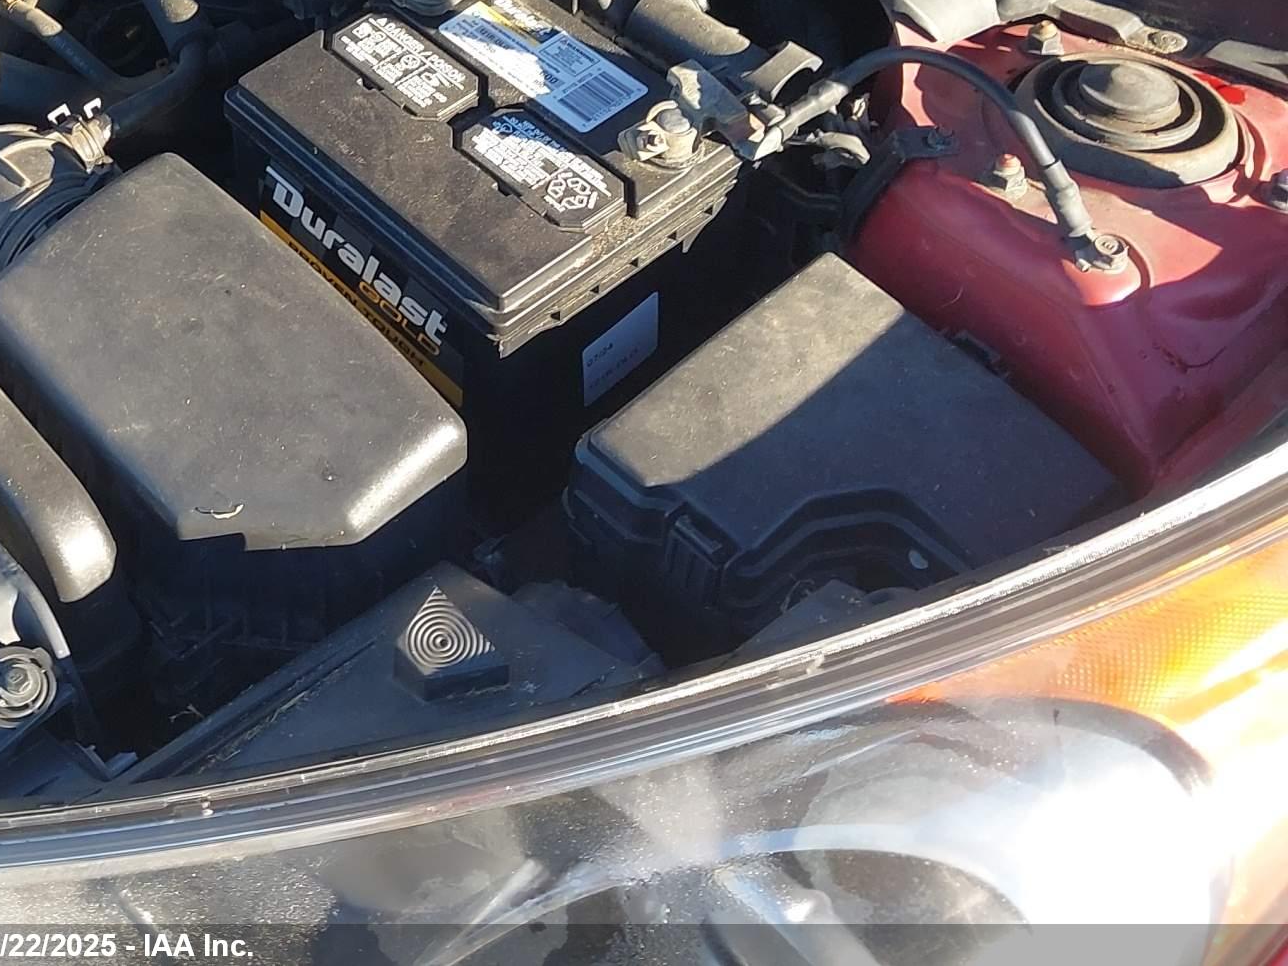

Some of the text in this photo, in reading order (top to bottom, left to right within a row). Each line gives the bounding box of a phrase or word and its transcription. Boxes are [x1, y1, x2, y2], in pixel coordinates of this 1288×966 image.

[385, 23, 425, 56] DANGER
[427, 55, 466, 83] POISON
[266, 165, 448, 346] Duralast
[360, 281, 440, 356] GOLD
